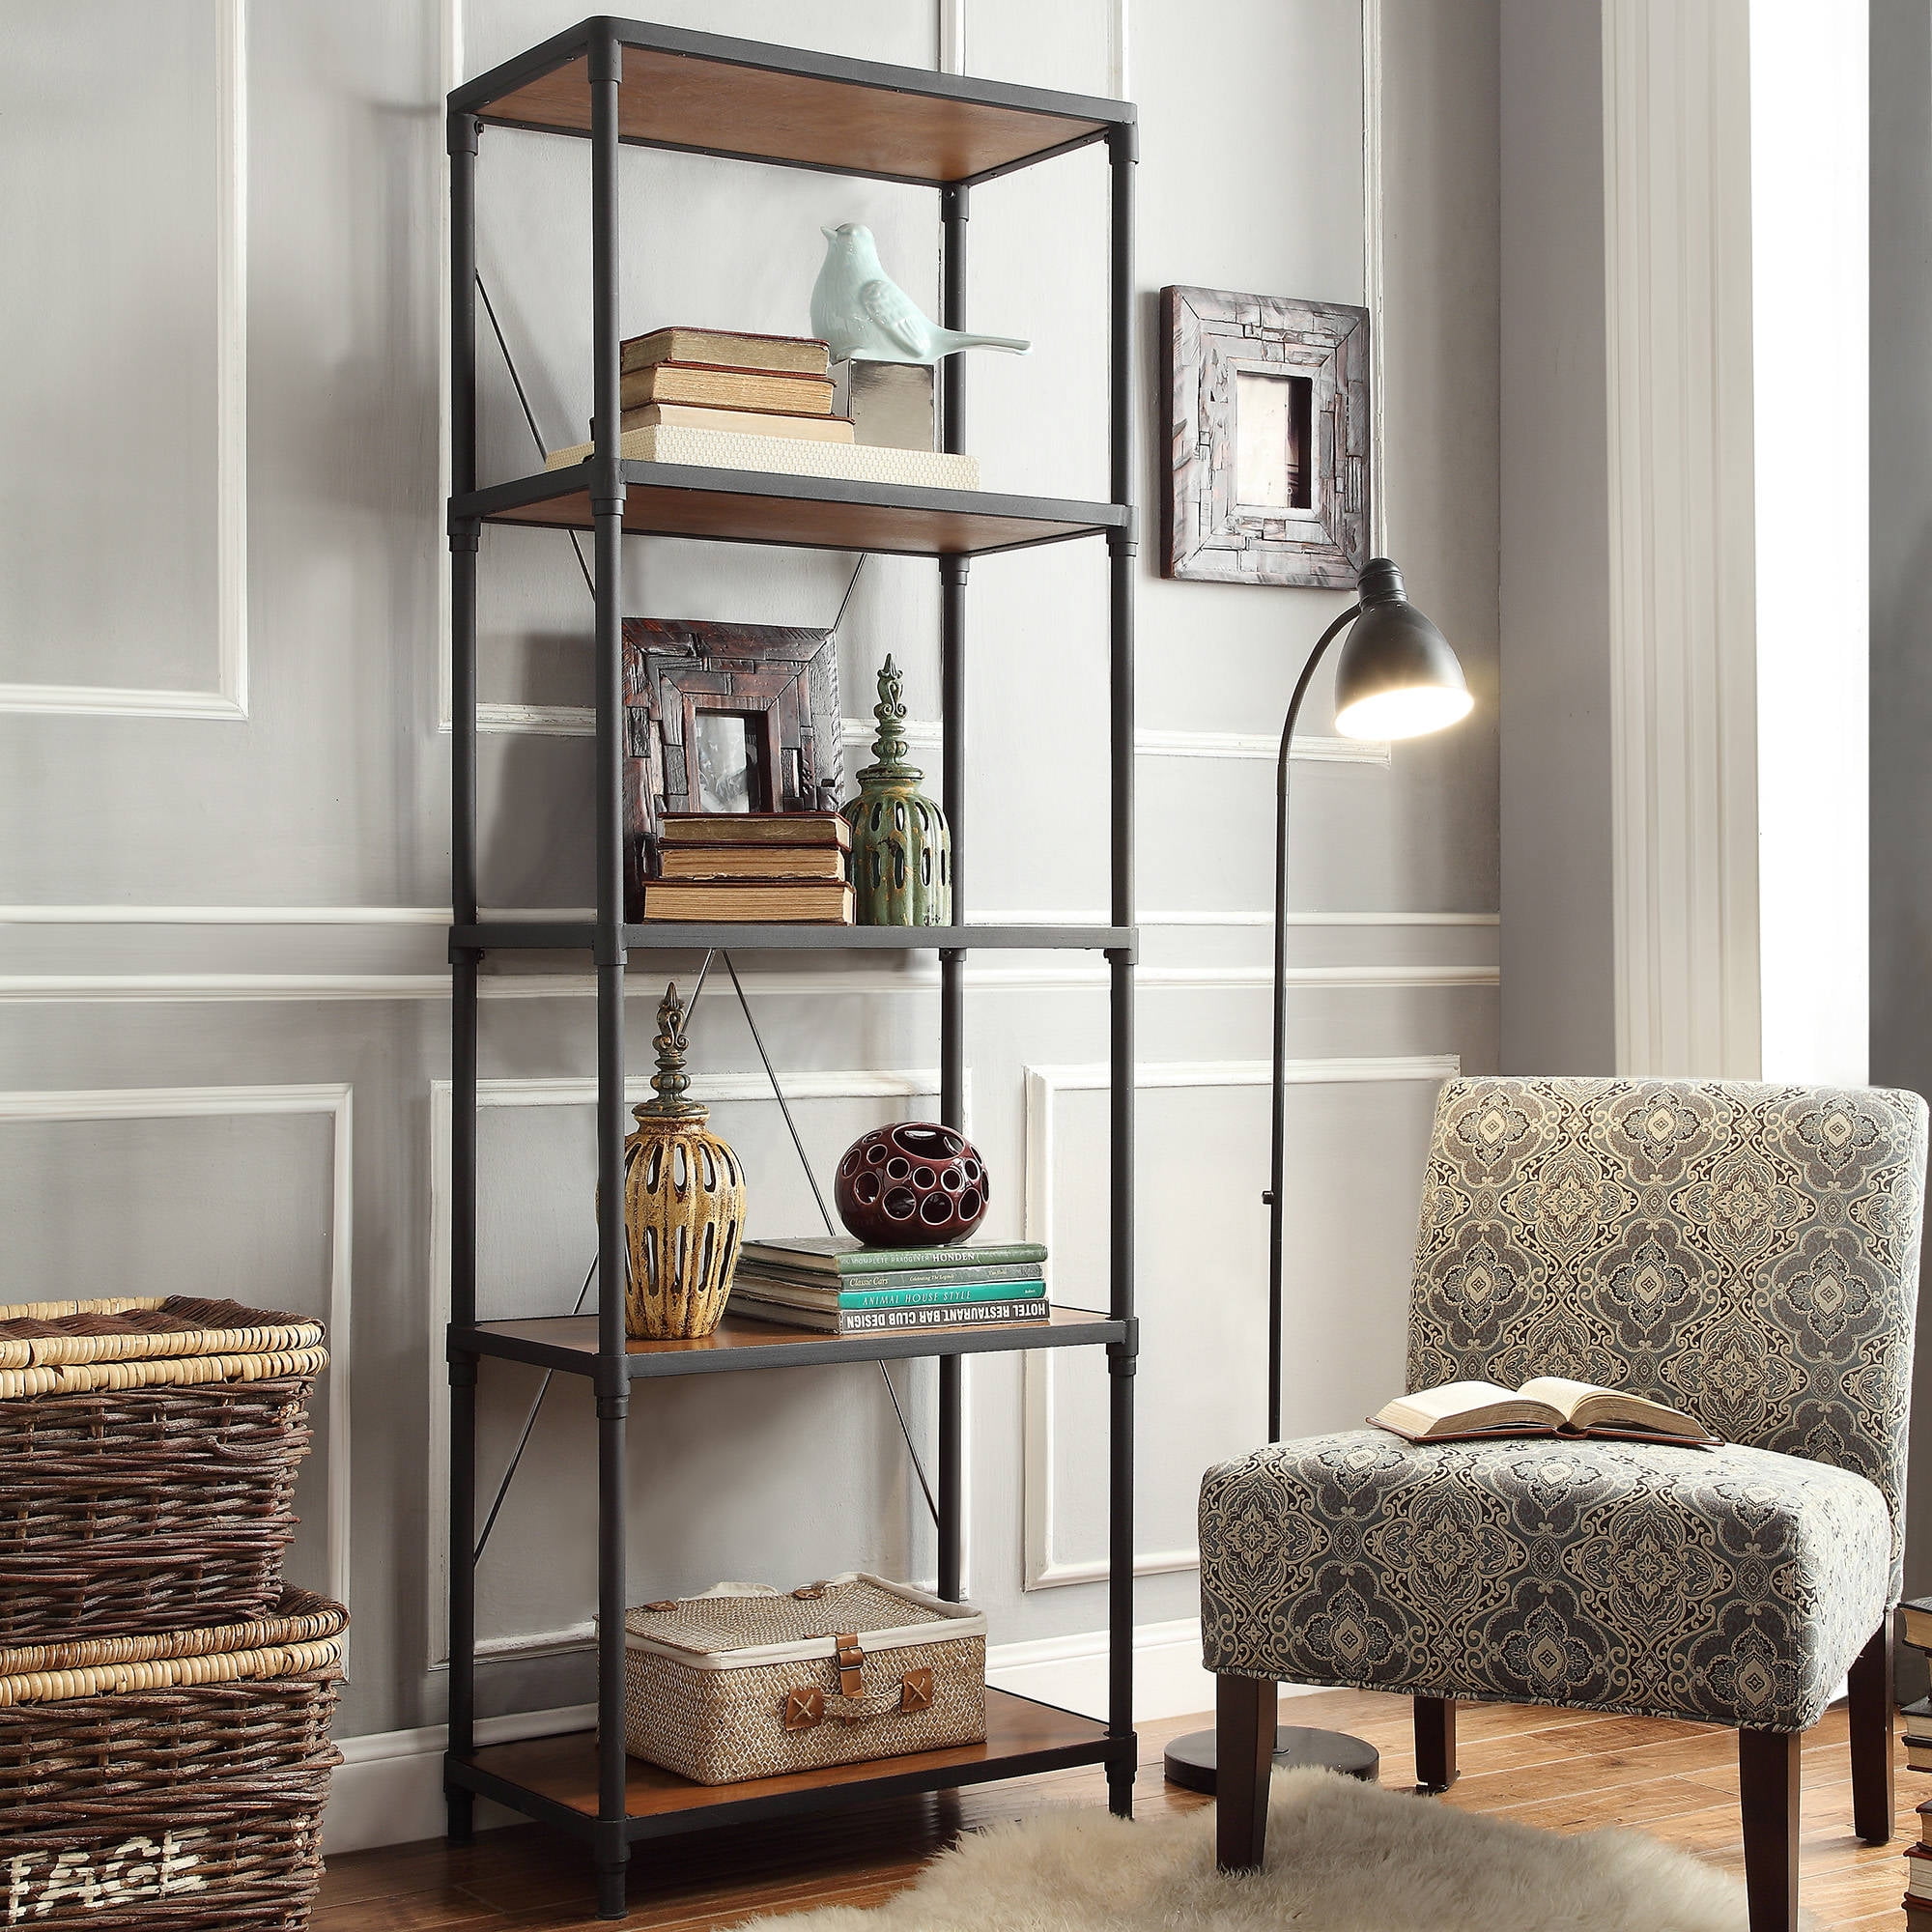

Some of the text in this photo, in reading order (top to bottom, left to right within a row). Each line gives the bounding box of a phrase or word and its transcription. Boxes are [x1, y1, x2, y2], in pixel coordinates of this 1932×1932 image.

[933, 1252, 975, 1263] HONDEN
[849, 1276, 889, 1287] Classic Cars
[863, 1291, 971, 1305] ANIMAL HOUSE STYLE
[919, 1310, 940, 1323] BAR
[1012, 1303, 1045, 1317] HOTEL
[846, 1313, 886, 1328] DESIGN
[889, 1311, 916, 1325] CLUB
